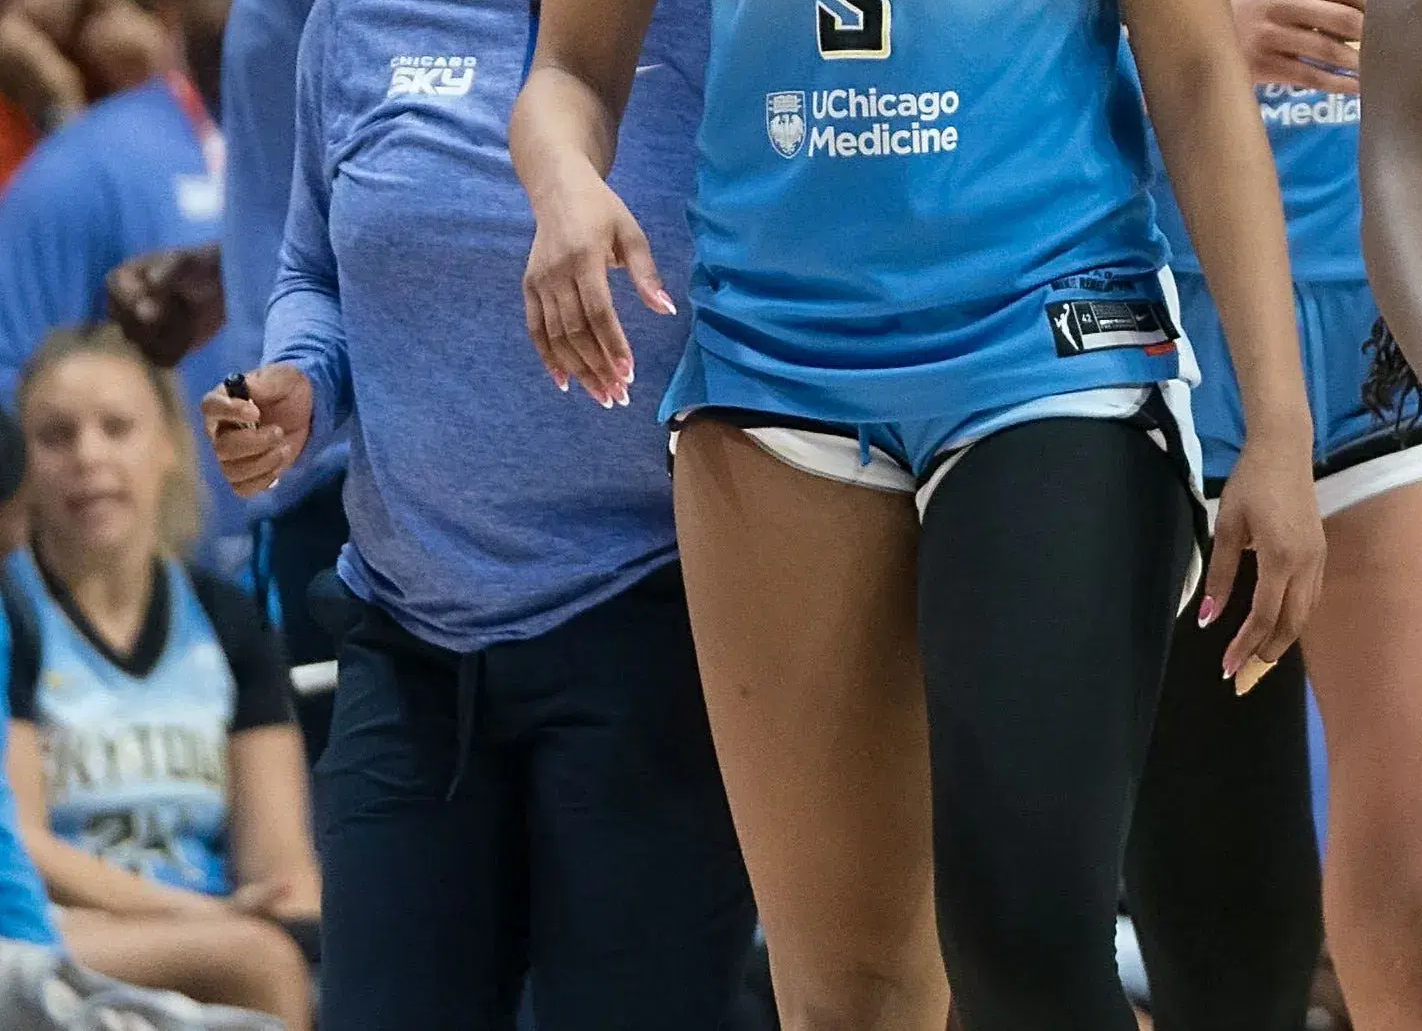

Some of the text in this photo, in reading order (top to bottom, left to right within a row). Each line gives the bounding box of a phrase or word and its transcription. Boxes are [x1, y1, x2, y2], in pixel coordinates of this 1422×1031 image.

[390, 56, 477, 68] CHICAGO
[387, 67, 474, 97] SKY
[812, 87, 960, 121] UChicago
[1260, 93, 1360, 125] Medic
[808, 121, 959, 157] Medicine
